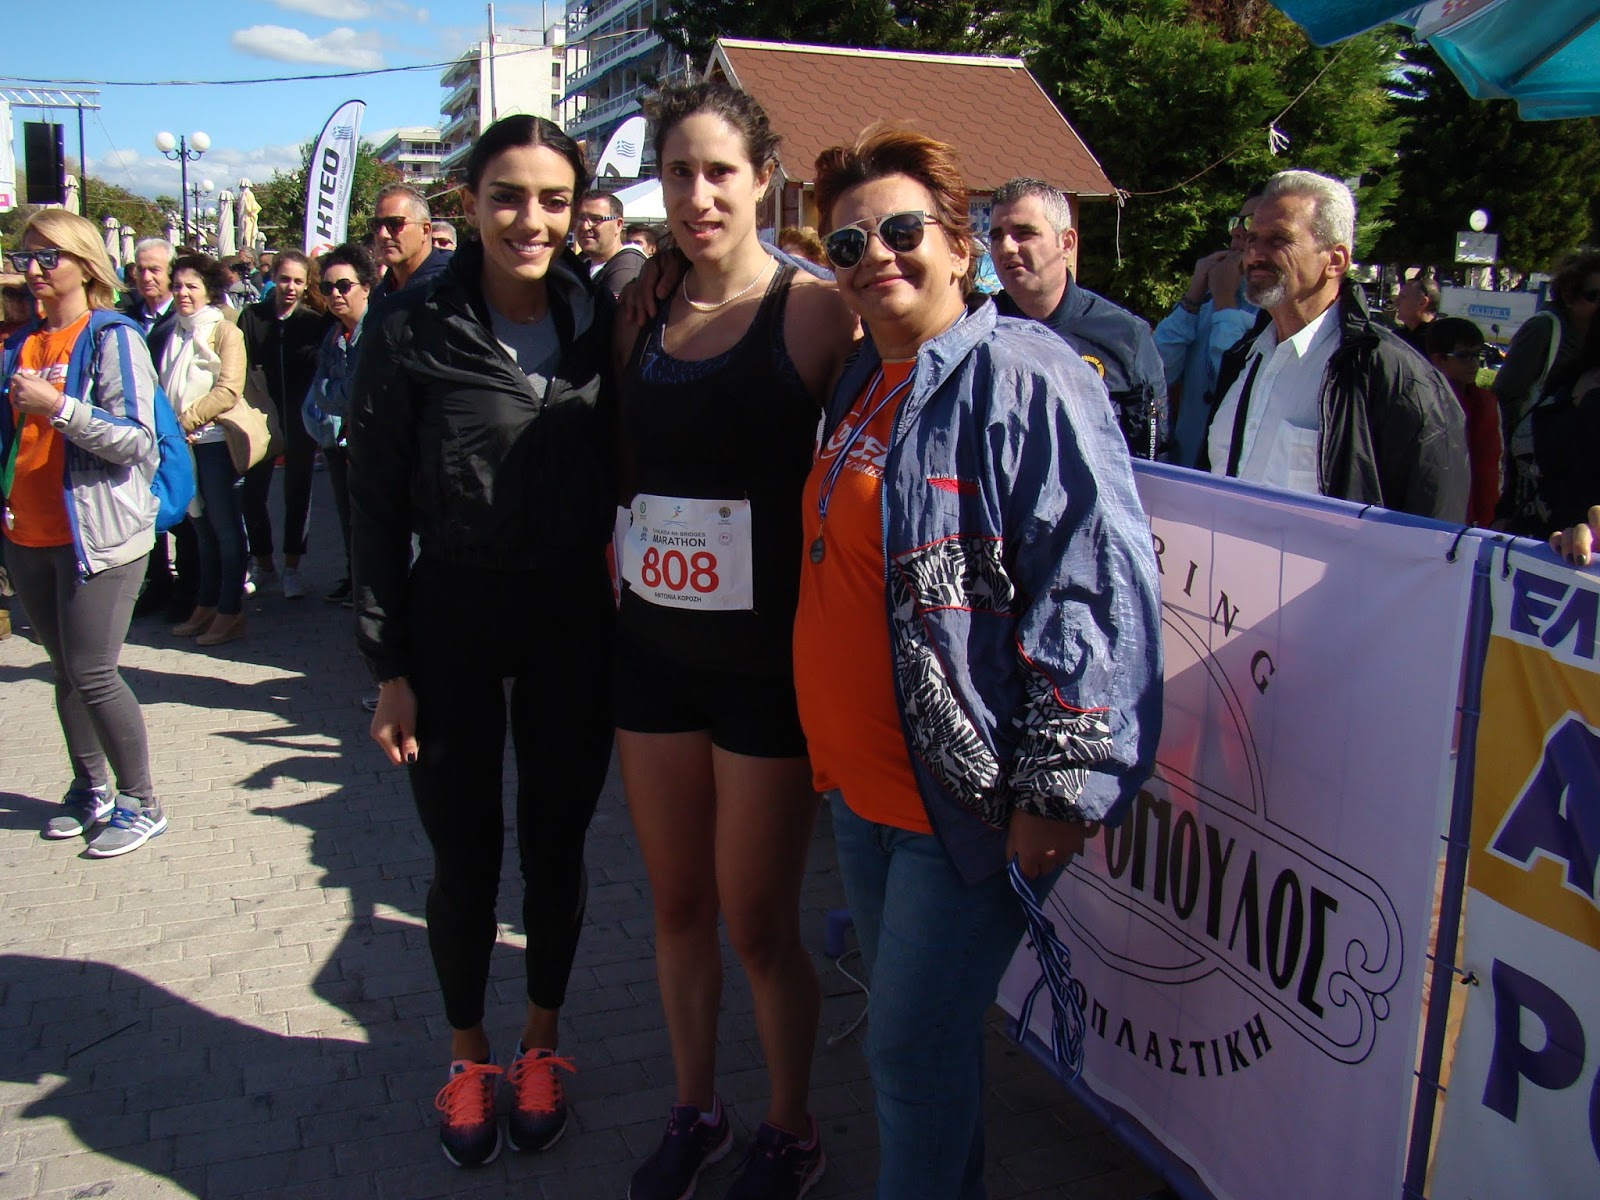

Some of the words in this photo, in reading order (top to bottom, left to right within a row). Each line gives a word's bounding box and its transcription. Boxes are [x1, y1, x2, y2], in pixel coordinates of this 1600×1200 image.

[1149, 418, 1157, 460] DESIGNIN
[641, 546, 720, 593] 808
[652, 534, 706, 547] MARATHON
[1151, 532, 1275, 695] RING
[1510, 567, 1600, 660] ΕΛ
[1489, 714, 1600, 900] Α
[1081, 789, 1338, 1019] ΟΠΟΥΛΟΣ
[1070, 978, 1272, 1077] ΟΠΛΑΣΤΙΚΗ
[1482, 957, 1600, 1164] Ρ
